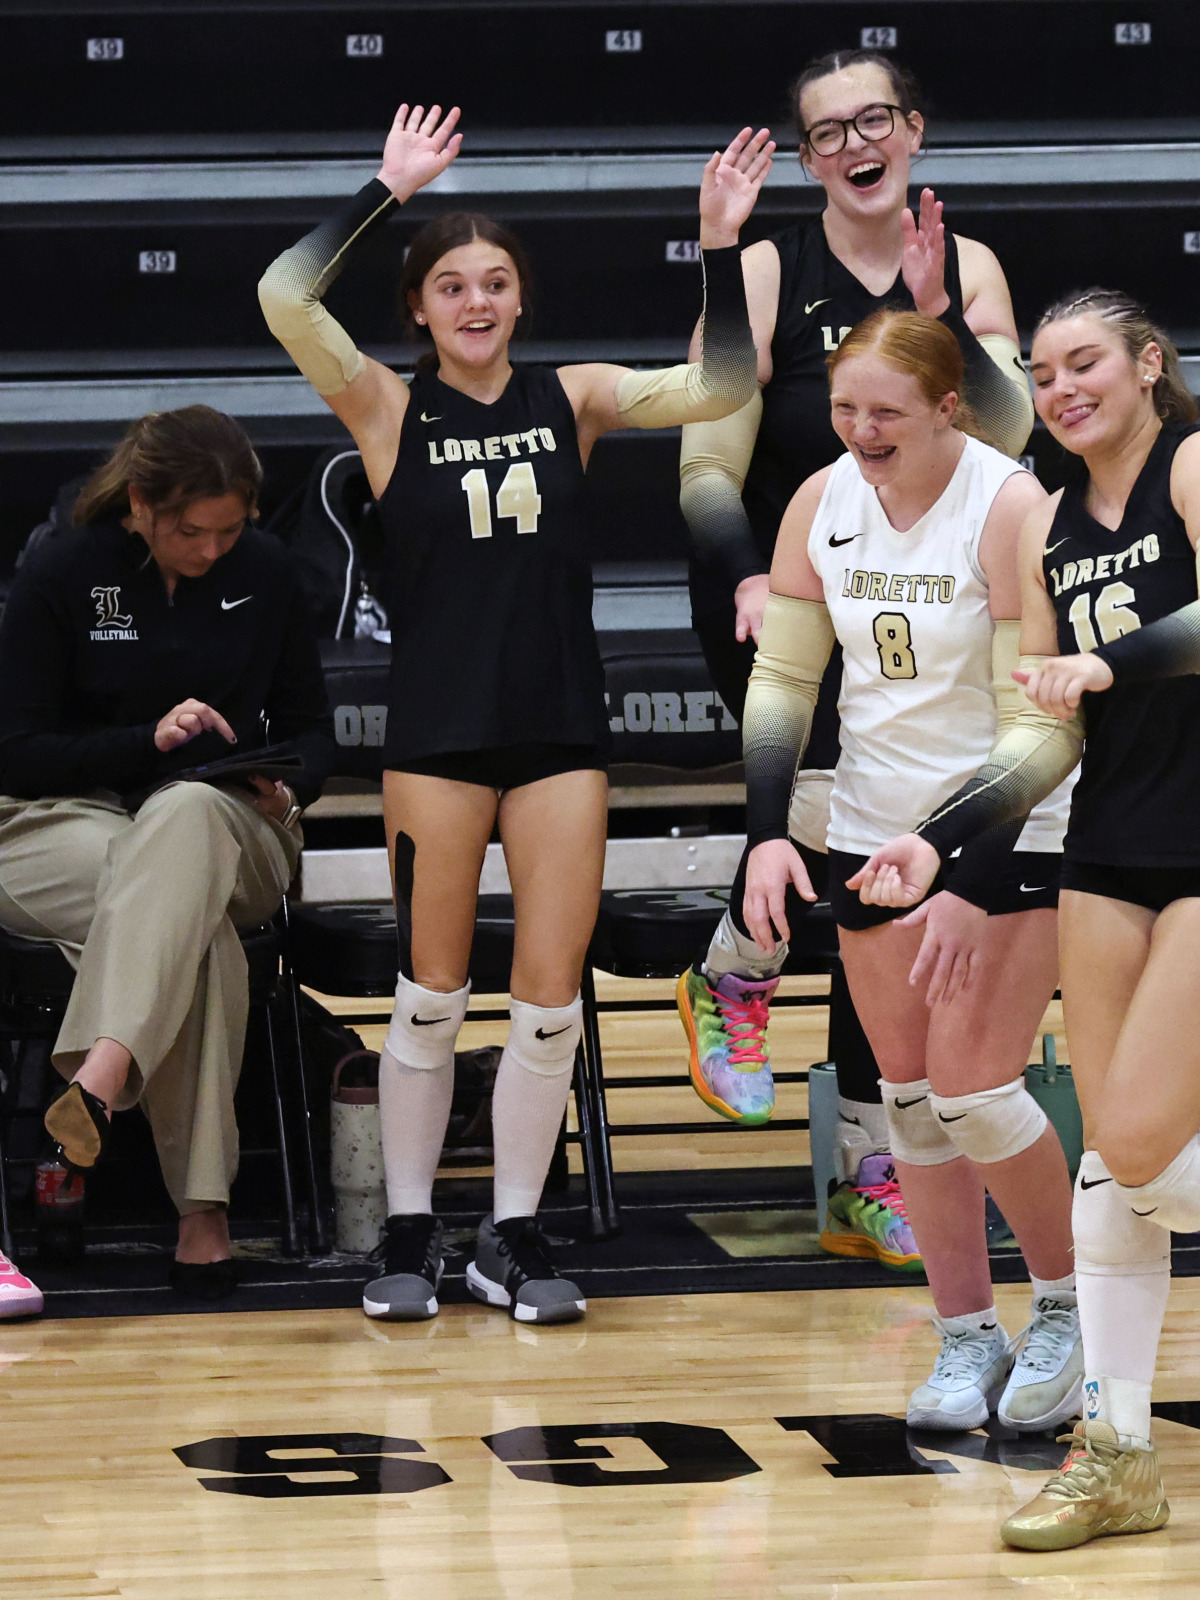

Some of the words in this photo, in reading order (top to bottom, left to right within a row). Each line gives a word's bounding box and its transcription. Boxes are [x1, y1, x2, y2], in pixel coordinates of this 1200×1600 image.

[610, 30, 638, 51] 41
[864, 27, 893, 48] 42
[1118, 23, 1147, 44] 43
[91, 38, 120, 60] 39
[351, 35, 380, 57] 40
[144, 250, 172, 271] 39
[671, 241, 698, 261] 41
[428, 427, 557, 465] LORETTO
[461, 461, 542, 539] 14
[1050, 533, 1160, 597] LORETTO
[842, 568, 956, 604] LORETTO
[90, 586, 133, 628] L
[1069, 580, 1142, 654] 16
[89, 629, 139, 641] VOLLEYBALL
[872, 611, 918, 681] 8
